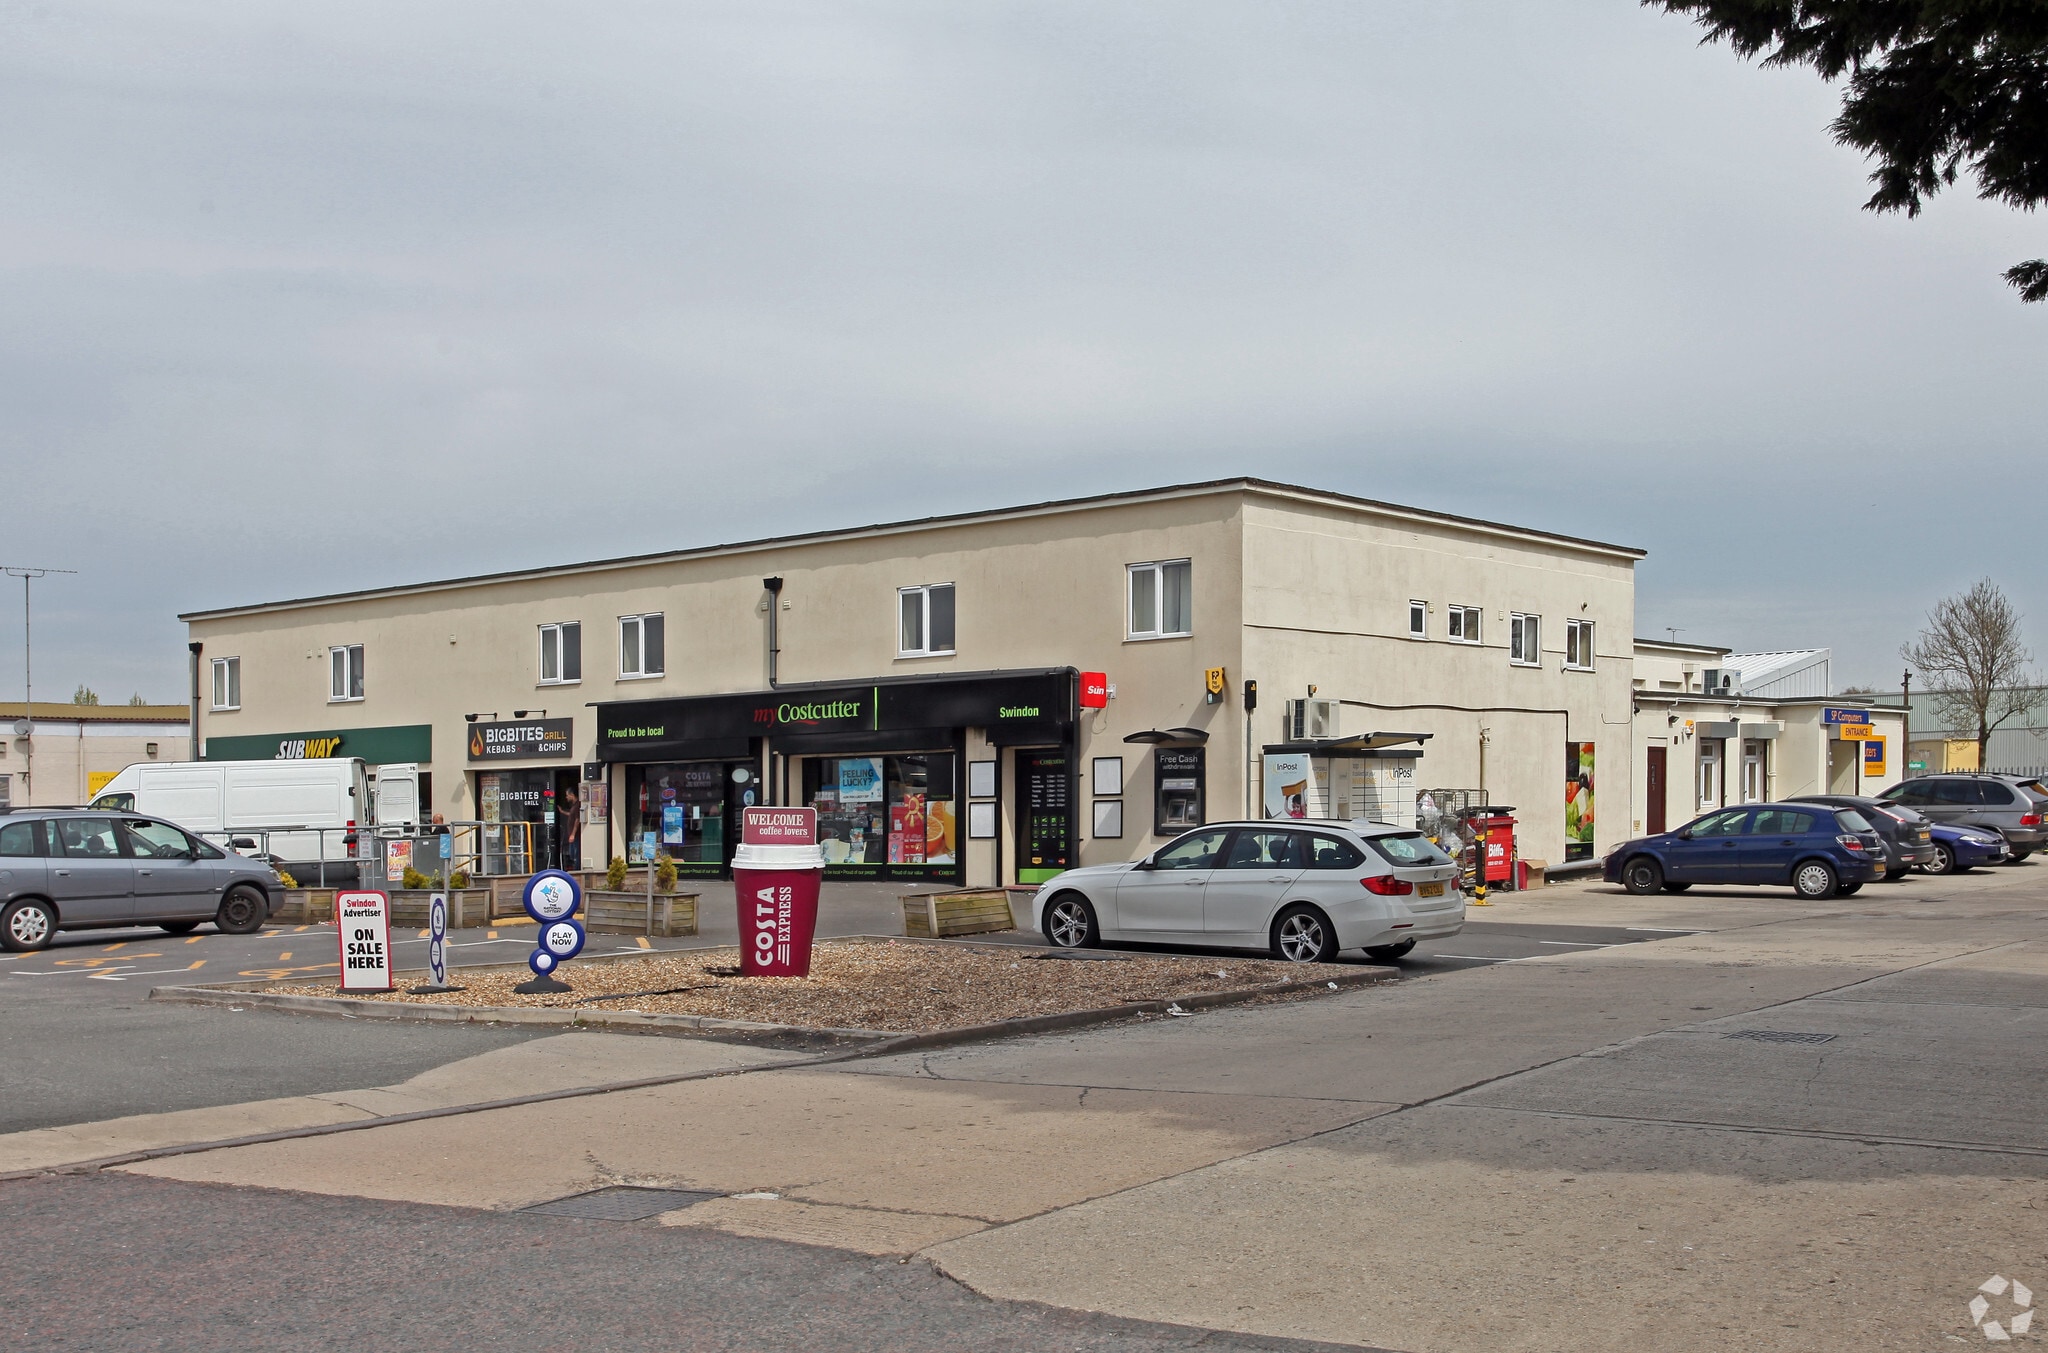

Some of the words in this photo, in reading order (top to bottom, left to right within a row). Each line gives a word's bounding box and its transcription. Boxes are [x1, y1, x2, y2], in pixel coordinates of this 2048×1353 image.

[1087, 685, 1104, 695] Sun
[1000, 706, 1039, 717] Swindon
[1831, 710, 1838, 720] SP
[1838, 711, 1862, 723] Computers
[544, 731, 567, 740] GRILL
[608, 728, 628, 738] Proud
[629, 728, 636, 737] to
[637, 727, 646, 736] be
[647, 726, 664, 736] local
[1845, 728, 1868, 736] ENTRANCE
[275, 736, 340, 759] SUBWAY
[486, 744, 516, 754] KEBABS
[1160, 755, 1177, 763] Free
[1179, 755, 1198, 763] Cash
[686, 772, 711, 780] COSTA
[843, 769, 874, 779] FEELING
[1393, 768, 1413, 778] InPost
[843, 778, 873, 787] LUCKY?
[500, 791, 539, 801] BIGBITES
[748, 814, 804, 826] WELCOME
[759, 827, 782, 836] coffee
[784, 827, 808, 836] lovers
[1488, 844, 1504, 857] Biffa
[347, 899, 376, 907] Swindon
[344, 909, 381, 917] Advertiser
[779, 886, 792, 942] EXPRESS
[755, 886, 777, 967] COSTA
[354, 929, 374, 940] ON
[348, 943, 382, 954] SALE
[348, 957, 384, 968] HERE
